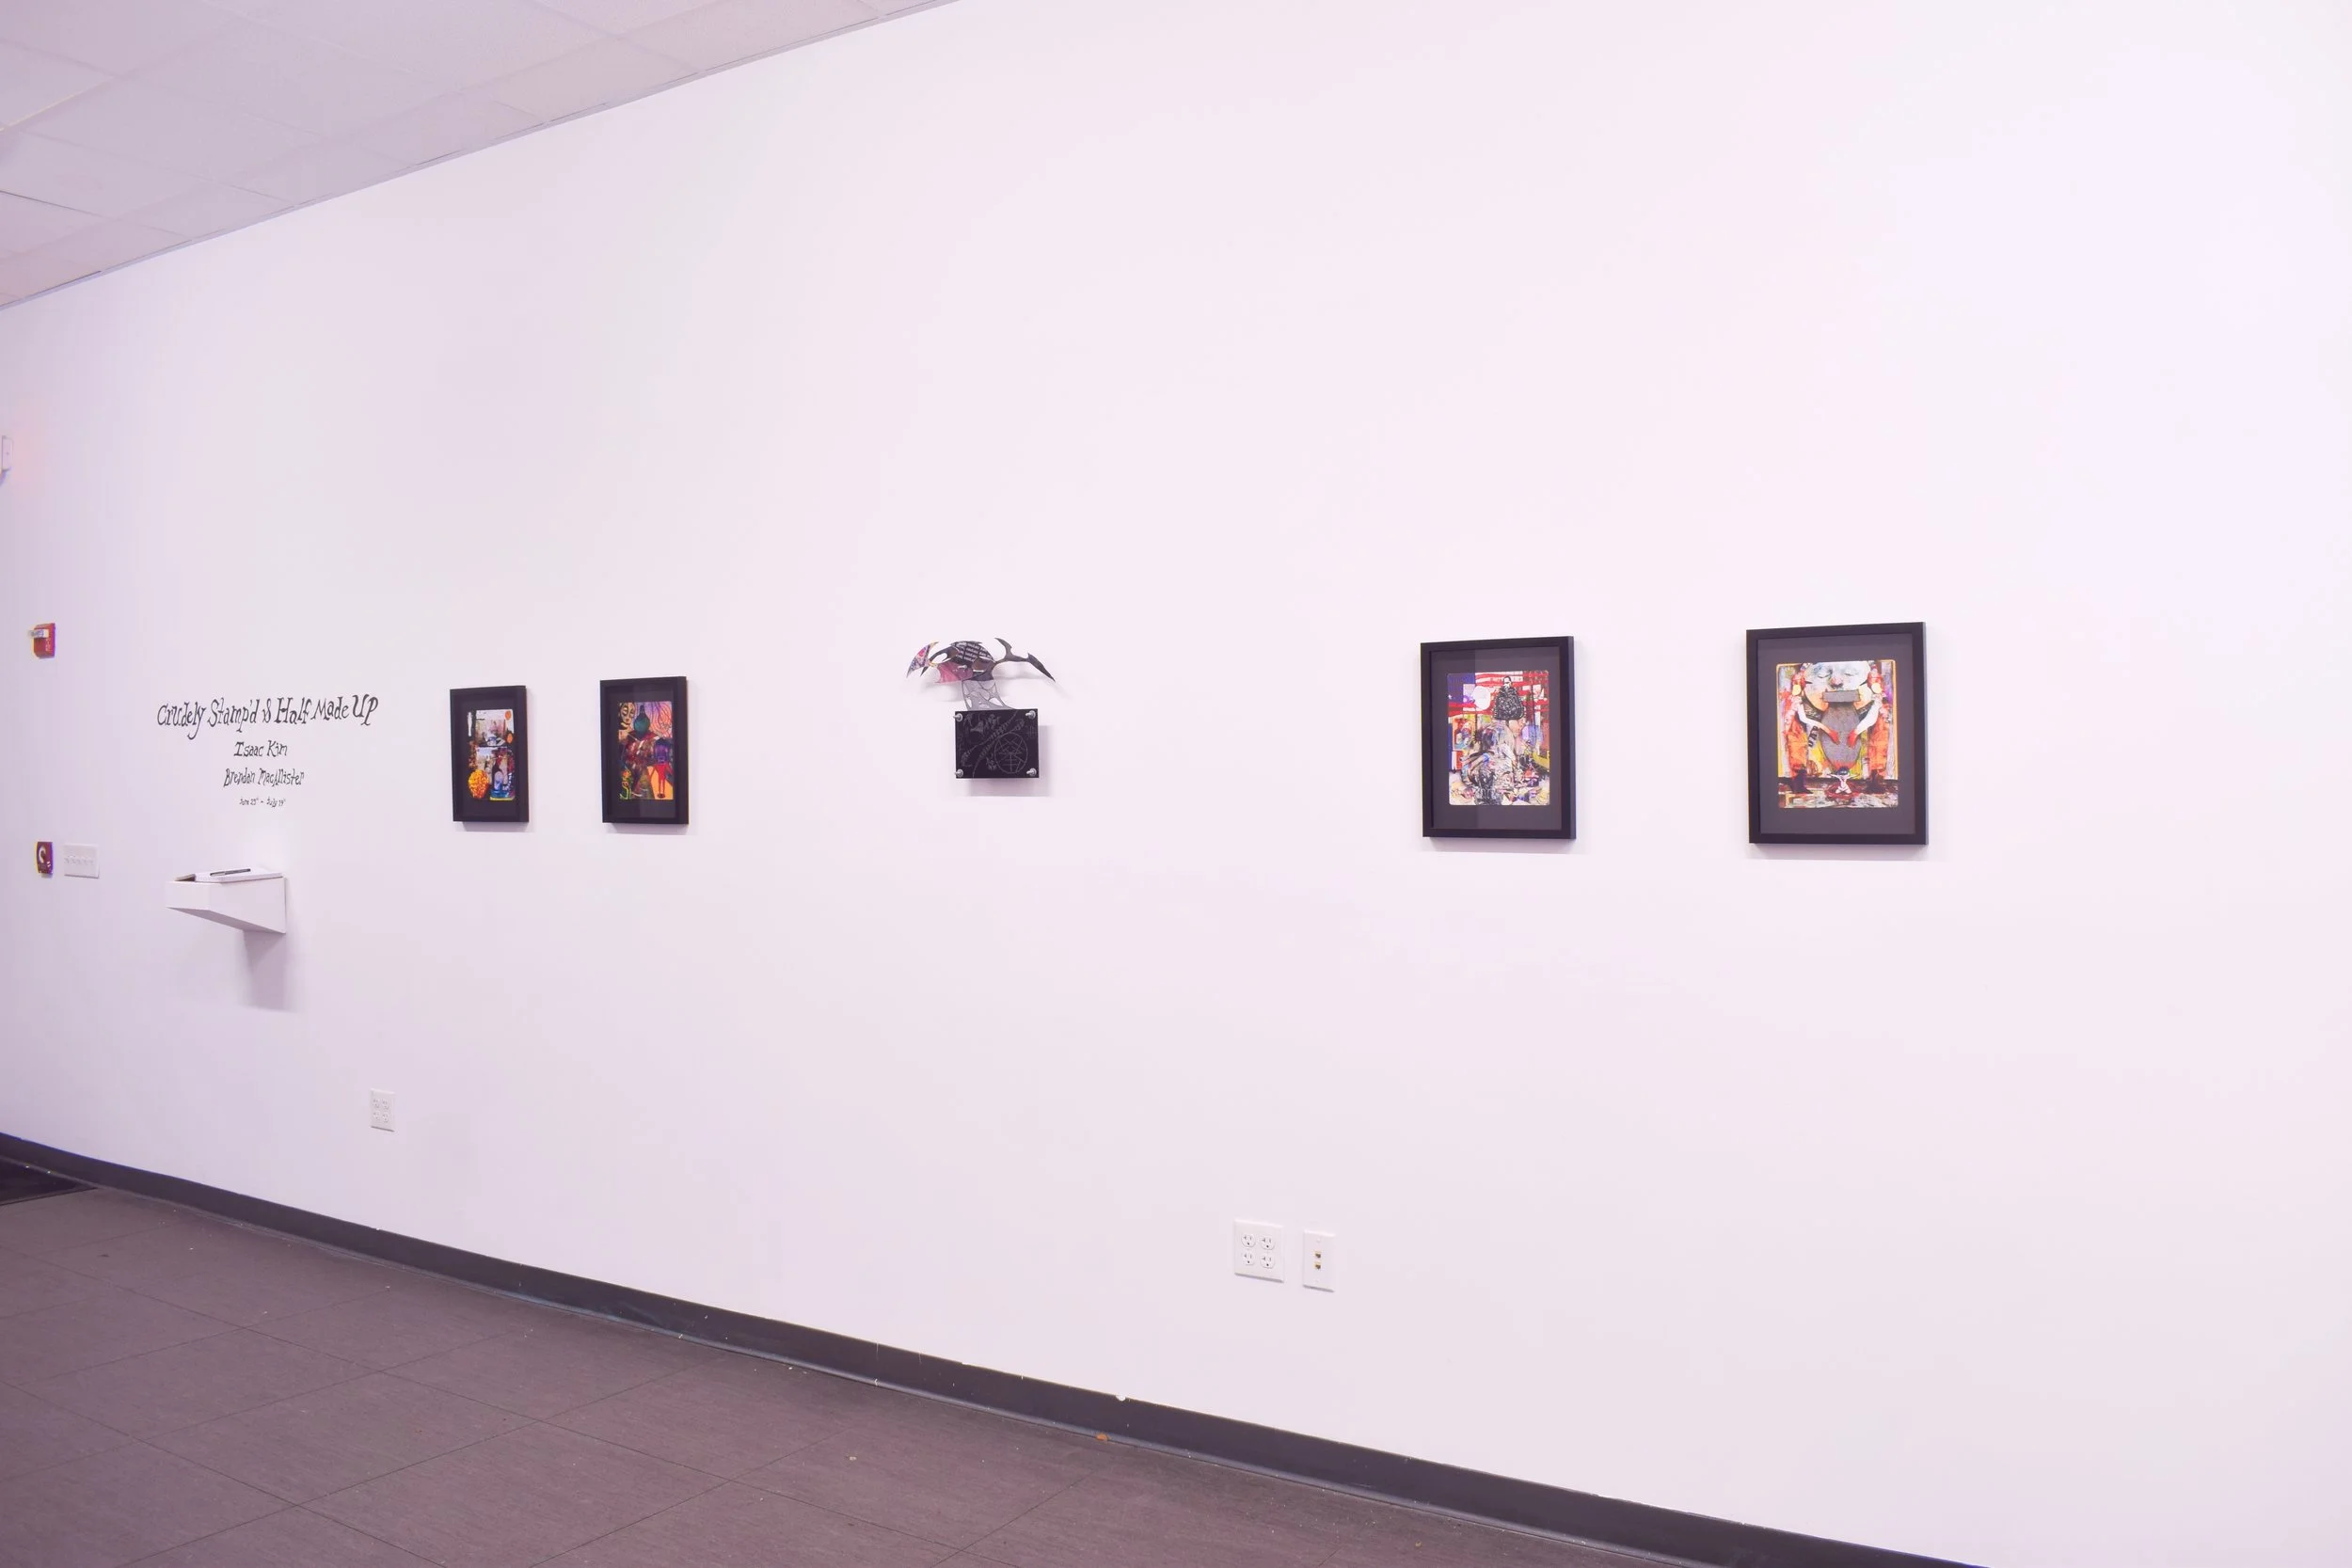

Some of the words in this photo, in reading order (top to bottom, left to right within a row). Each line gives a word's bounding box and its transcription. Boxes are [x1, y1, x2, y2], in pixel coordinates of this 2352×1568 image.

[157, 701, 207, 740] Crudely
[207, 697, 261, 734] Stamp'd
[262, 698, 272, 724] &
[274, 697, 312, 724] Half
[311, 696, 350, 721] Made
[233, 741, 264, 758] Isaac
[266, 740, 288, 758] Kim
[222, 768, 256, 788] Brendan
